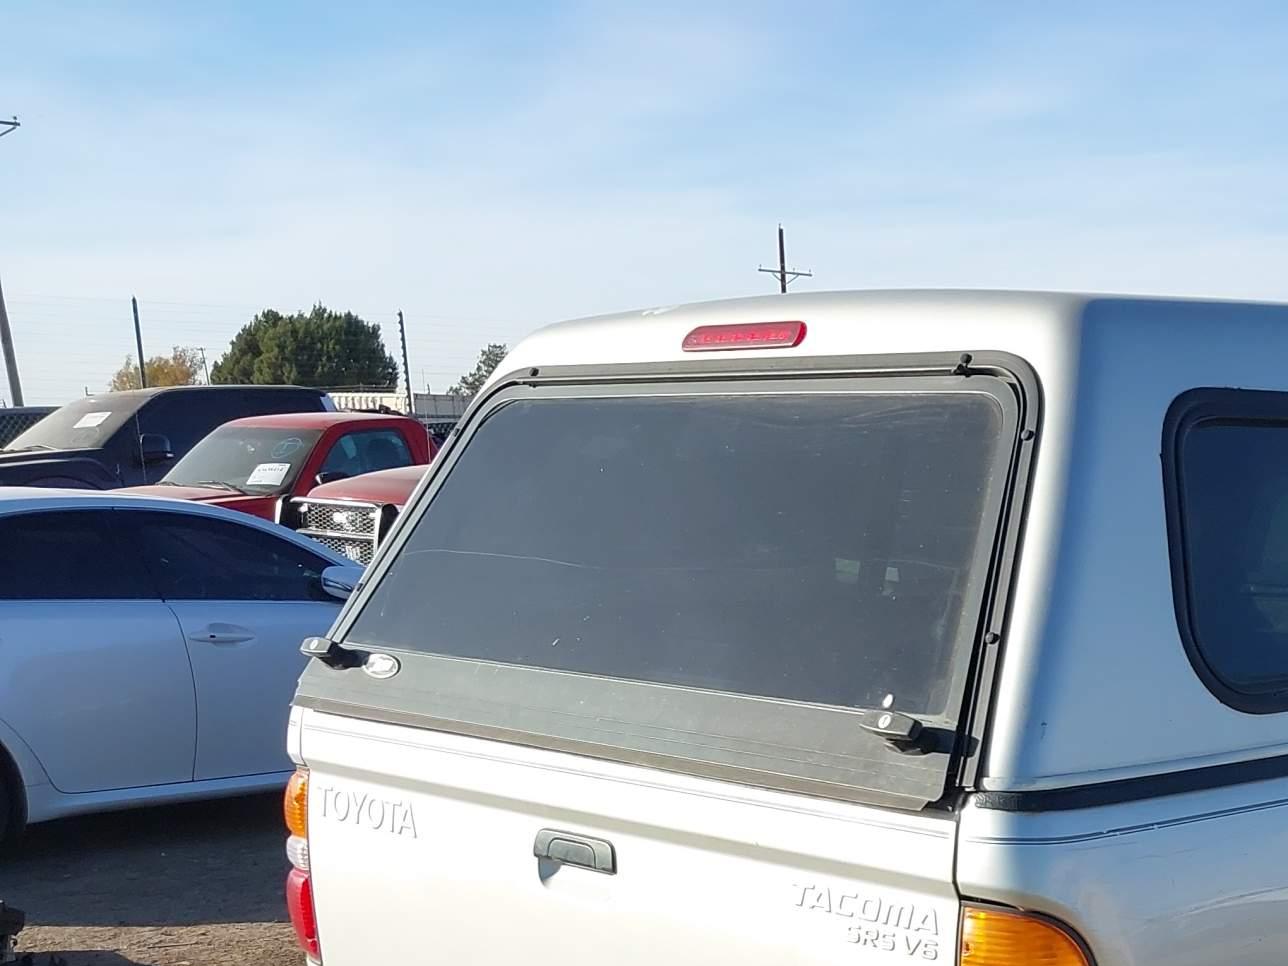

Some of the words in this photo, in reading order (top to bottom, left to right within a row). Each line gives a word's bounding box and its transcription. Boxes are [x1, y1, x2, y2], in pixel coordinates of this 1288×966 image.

[317, 786, 418, 839] TOYOTA
[792, 883, 939, 936] TACOMA
[905, 935, 939, 961] V6
